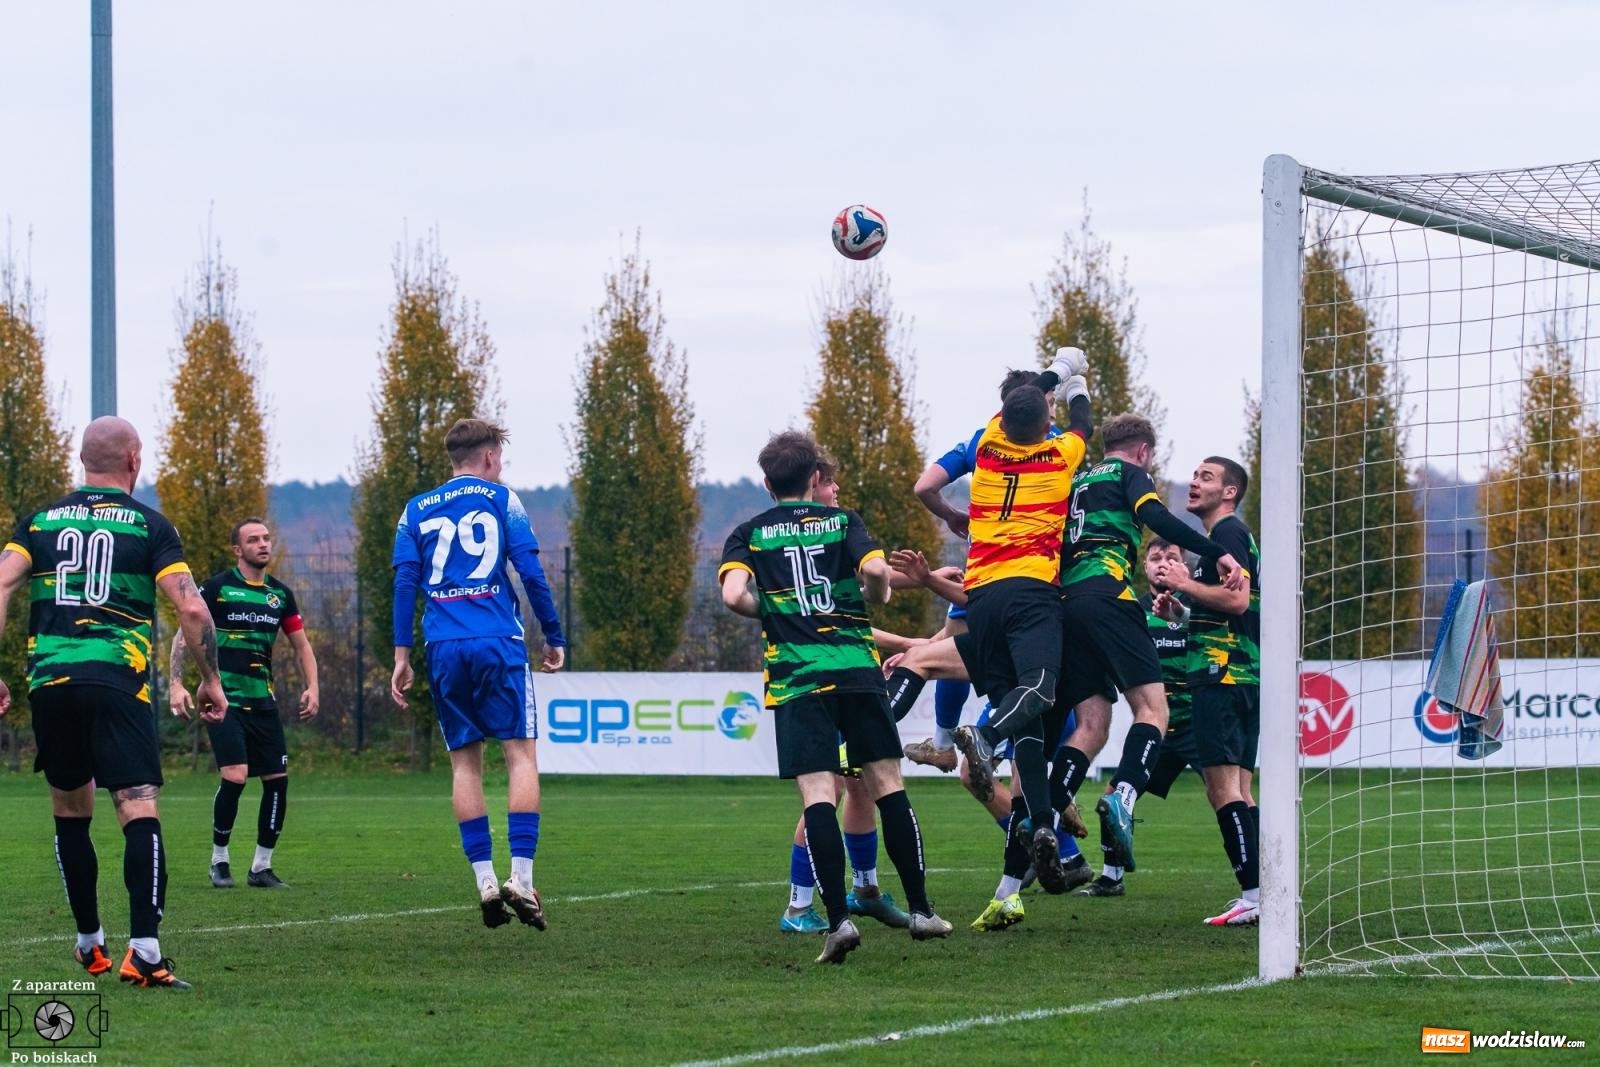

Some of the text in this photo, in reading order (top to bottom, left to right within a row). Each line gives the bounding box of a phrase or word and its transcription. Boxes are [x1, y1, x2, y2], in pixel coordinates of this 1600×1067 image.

[418, 485, 497, 510] UNIA RACIBÓRZ
[1069, 483, 1089, 544] 5
[56, 527, 114, 606] 20
[418, 509, 499, 585] 79
[784, 544, 836, 617] 15
[1502, 688, 1600, 718] Marc
[1505, 725, 1569, 741] kspert
